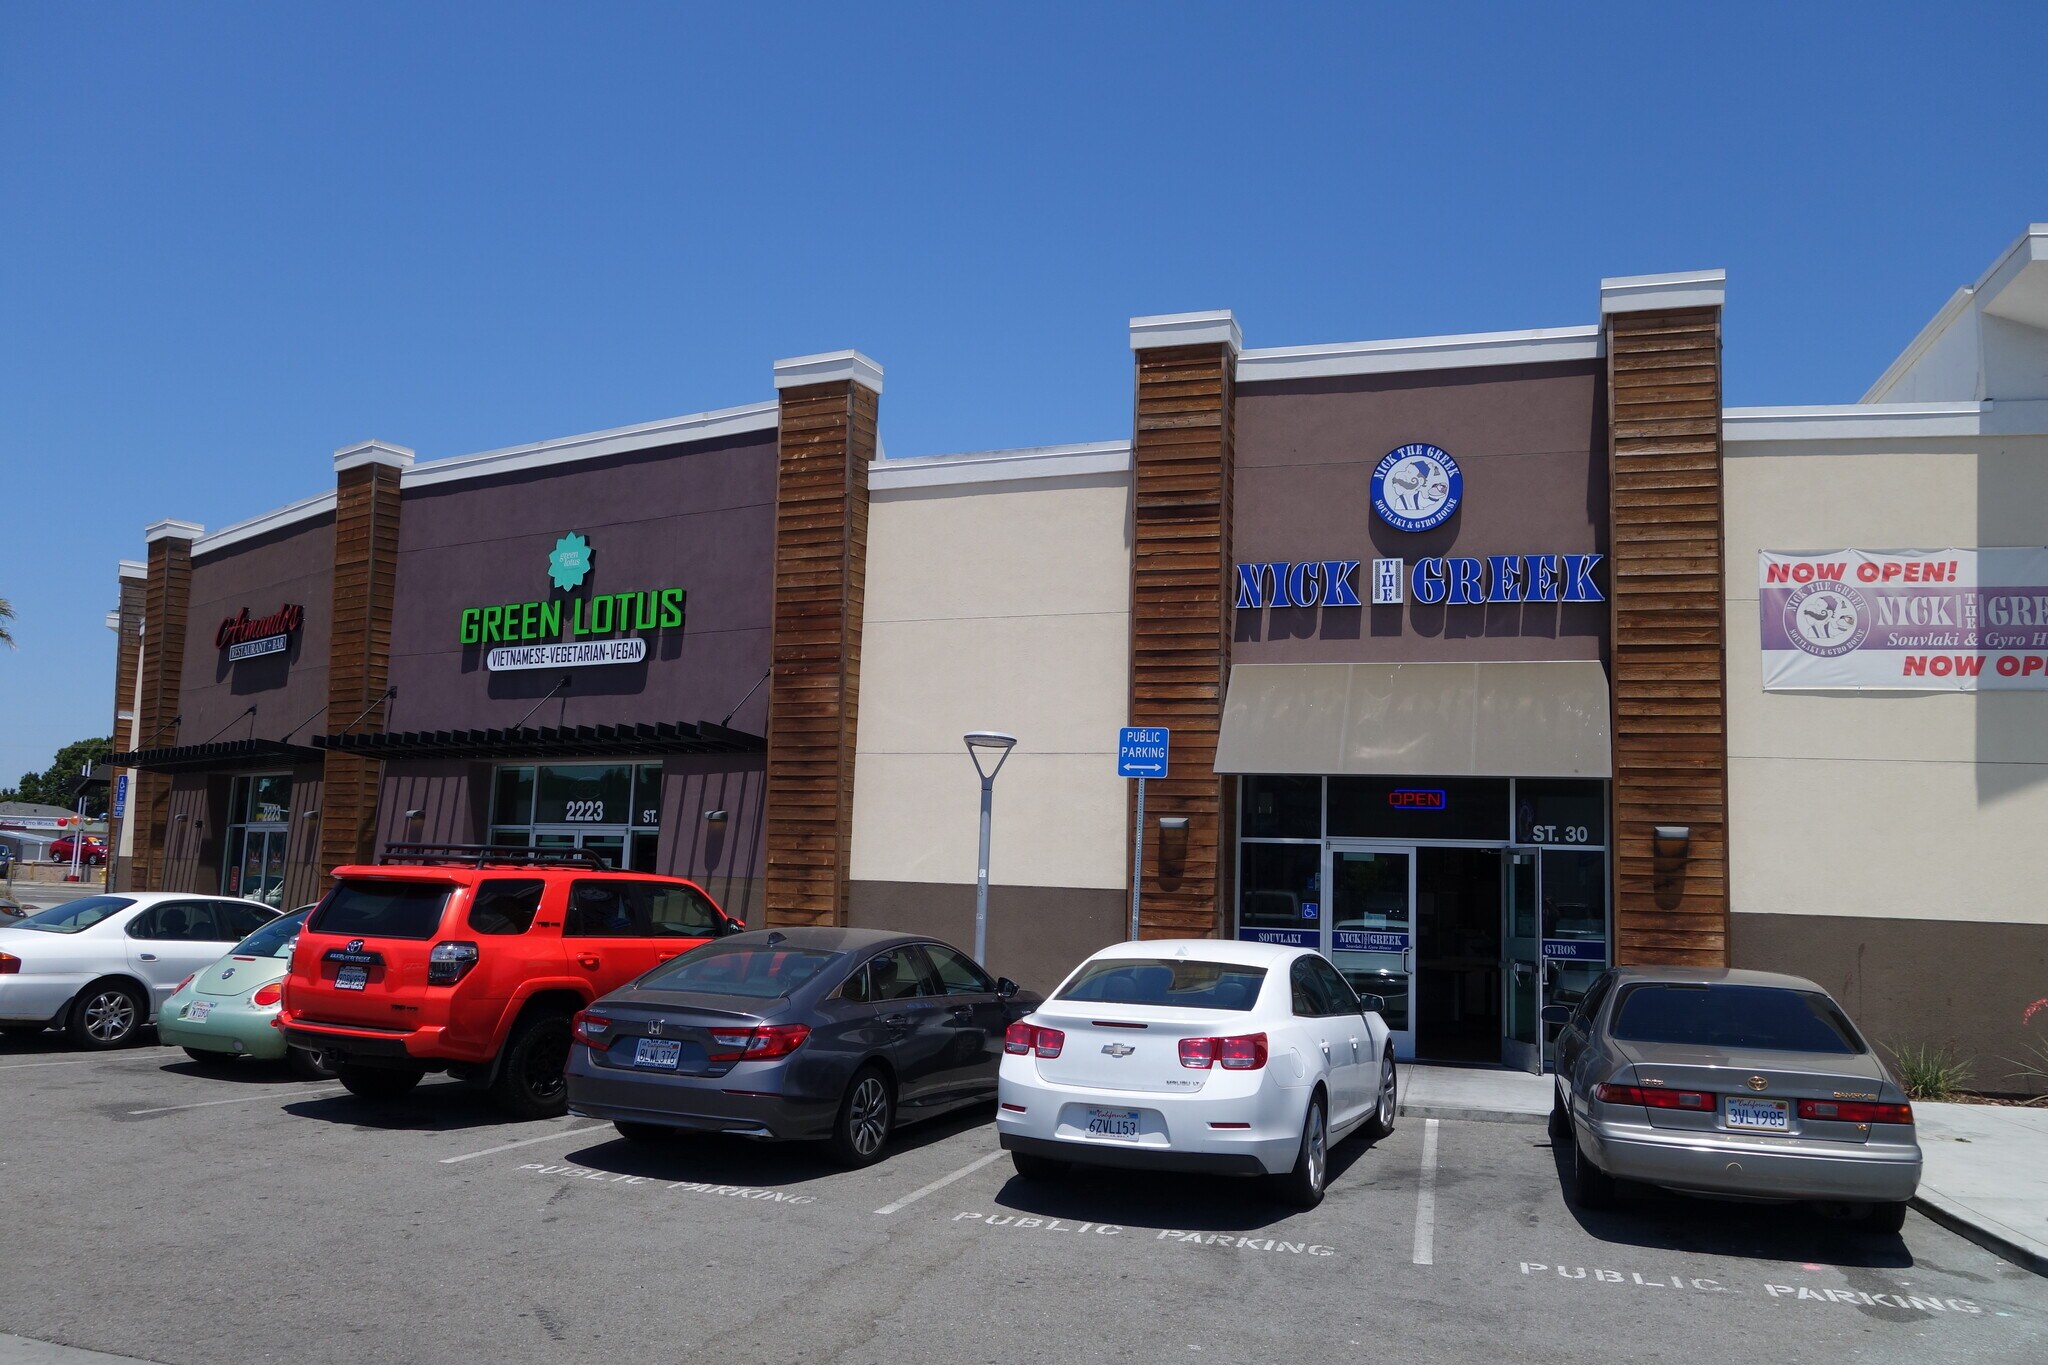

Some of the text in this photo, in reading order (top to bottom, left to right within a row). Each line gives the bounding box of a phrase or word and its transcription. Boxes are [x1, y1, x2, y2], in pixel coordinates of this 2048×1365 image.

[1374, 444, 1460, 479] NICK THE GREEK
[1375, 497, 1457, 529] SOUVLAKI & GYRO HOUSE
[1235, 554, 1606, 608] NICK THE GREEK
[1767, 561, 1958, 583] NOW OPEN!
[1787, 582, 1866, 612] NICK THE GREEK
[460, 587, 683, 644] GREEN LOTUS
[1876, 596, 1954, 626] NICK
[1965, 593, 1977, 629] THE
[231, 641, 267, 658] RESTAURANT
[272, 638, 285, 650] BAR
[1789, 628, 1819, 654] SOUVLAKI
[1827, 646, 1847, 655] GYRO
[1847, 629, 1865, 649] HOUSE
[1887, 632, 2048, 649] Souvlaki & Gyro H
[1903, 655, 2048, 677] NOW OP
[1127, 731, 1160, 743] PUBLIC
[1121, 746, 1165, 758] PARKING
[1389, 792, 1441, 806] OPEN
[263, 805, 281, 821] 2223
[565, 800, 604, 821] 2223
[643, 809, 657, 823] ST.
[1532, 825, 1588, 842] ST. 30
[1258, 932, 1302, 943] SOUVLAKI
[1339, 933, 1361, 943] NICK
[1370, 934, 1402, 946] GREEK
[1544, 944, 1577, 955] GYROS
[639, 1048, 678, 1064] 8LWL376
[1738, 1099, 1775, 1109] California
[1097, 1109, 1127, 1119] California
[1730, 1108, 1785, 1126] 3VLY985
[1089, 1118, 1136, 1136] 6ZVL153
[512, 1162, 818, 1204] PUBLIC PARKING
[952, 1211, 1336, 1256] PUBLIC PARKING
[1520, 1261, 1983, 1314] PUBLIC PARKING
